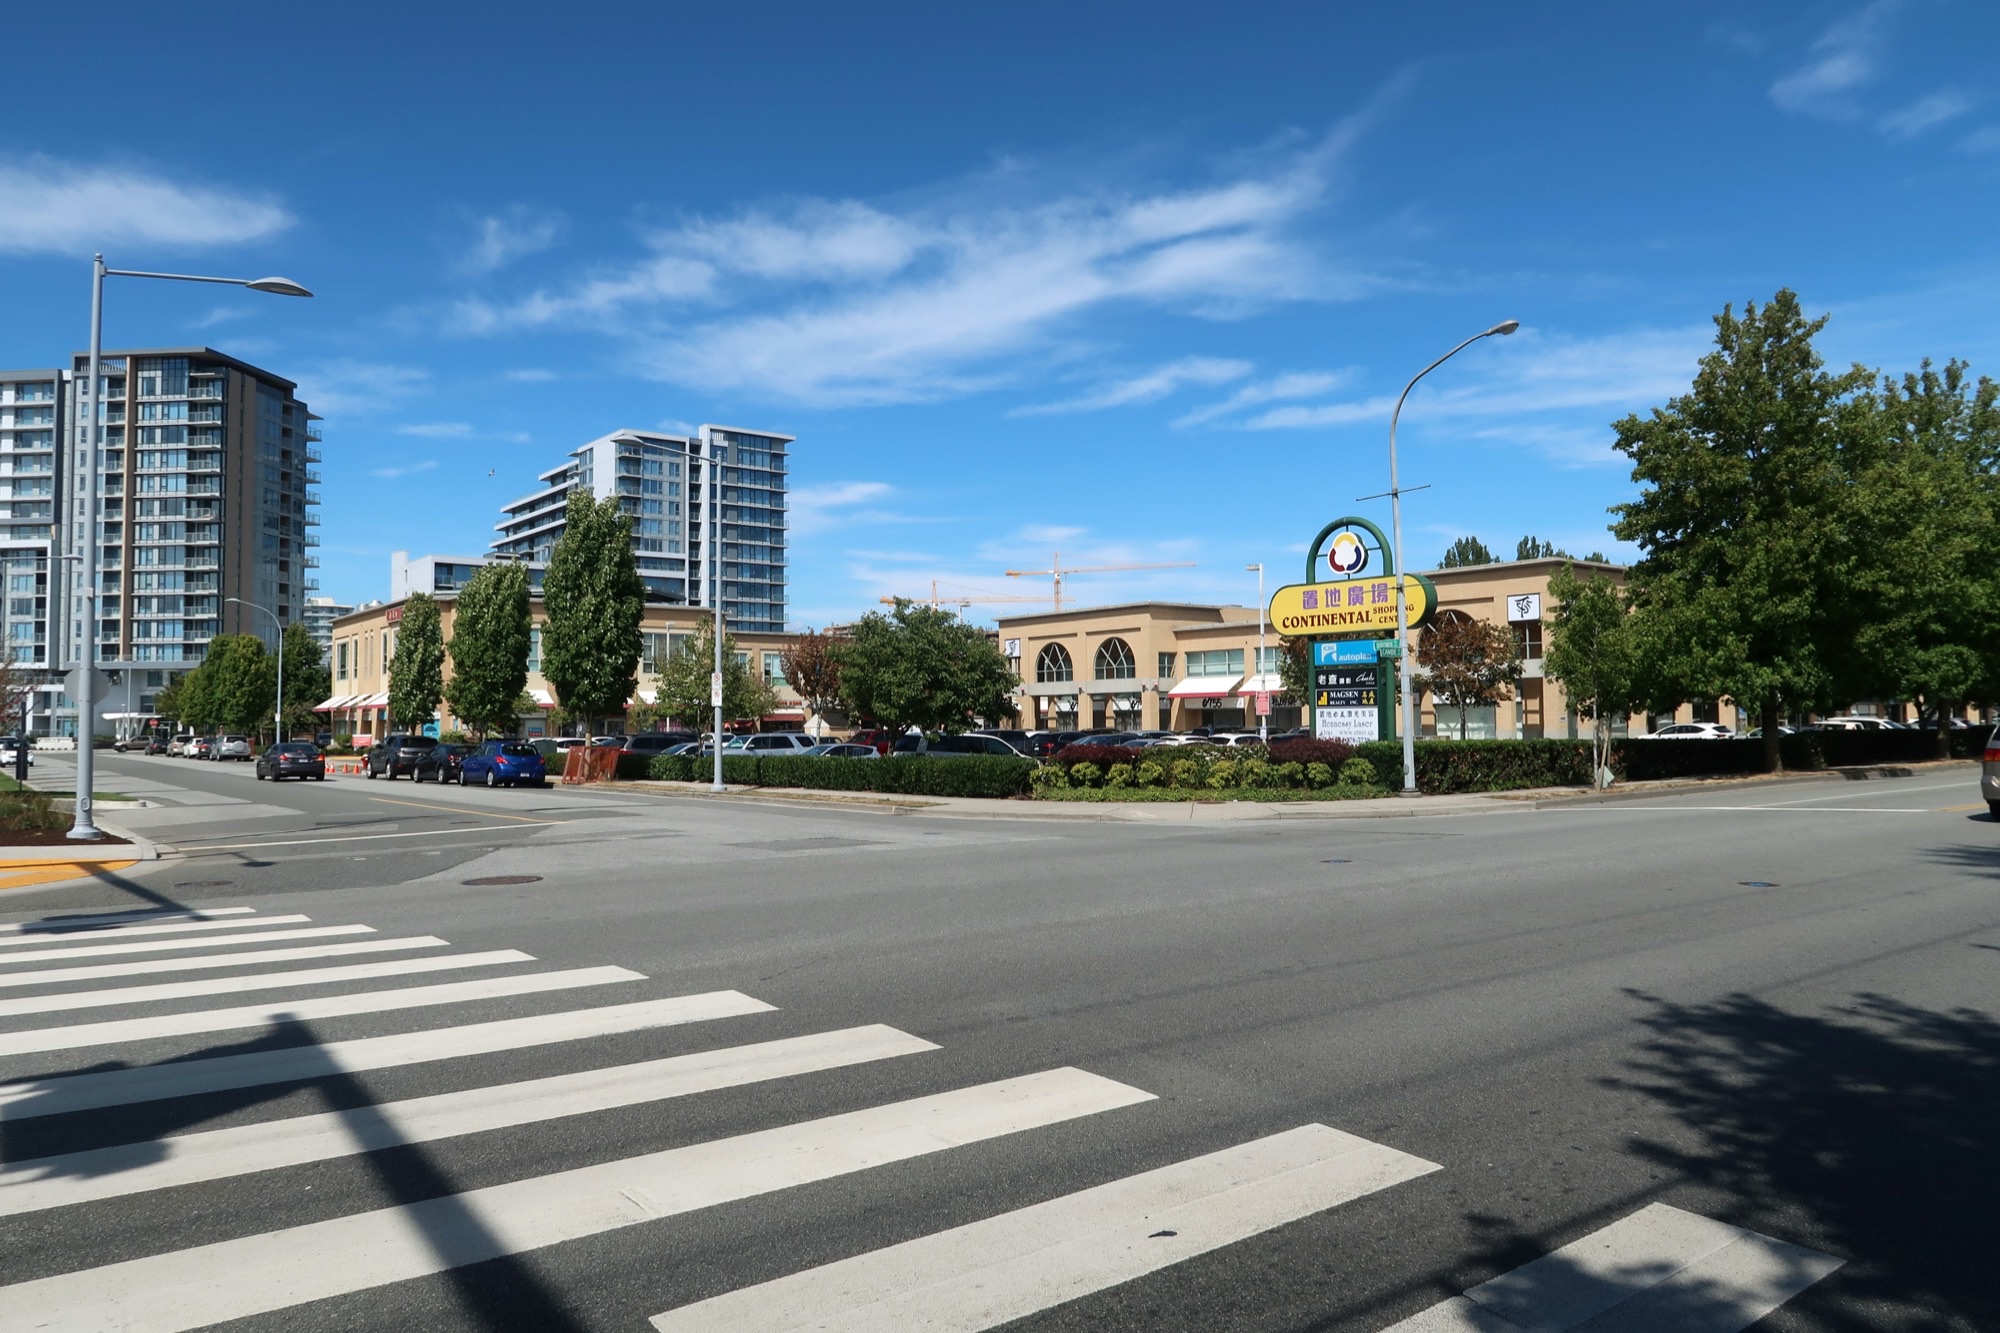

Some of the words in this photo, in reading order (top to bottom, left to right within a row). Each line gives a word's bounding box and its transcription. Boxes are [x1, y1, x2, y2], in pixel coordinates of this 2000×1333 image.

[1303, 583, 1389, 610] 置地廣場
[1373, 603, 1415, 614] SHOPNG
[1282, 610, 1372, 629] CONTINENTAL
[1339, 653, 1372, 662] autoplan
[1329, 690, 1359, 698] MAGSEN
[1321, 719, 1352, 730] Hennessy
[1353, 719, 1373, 728] Laser
